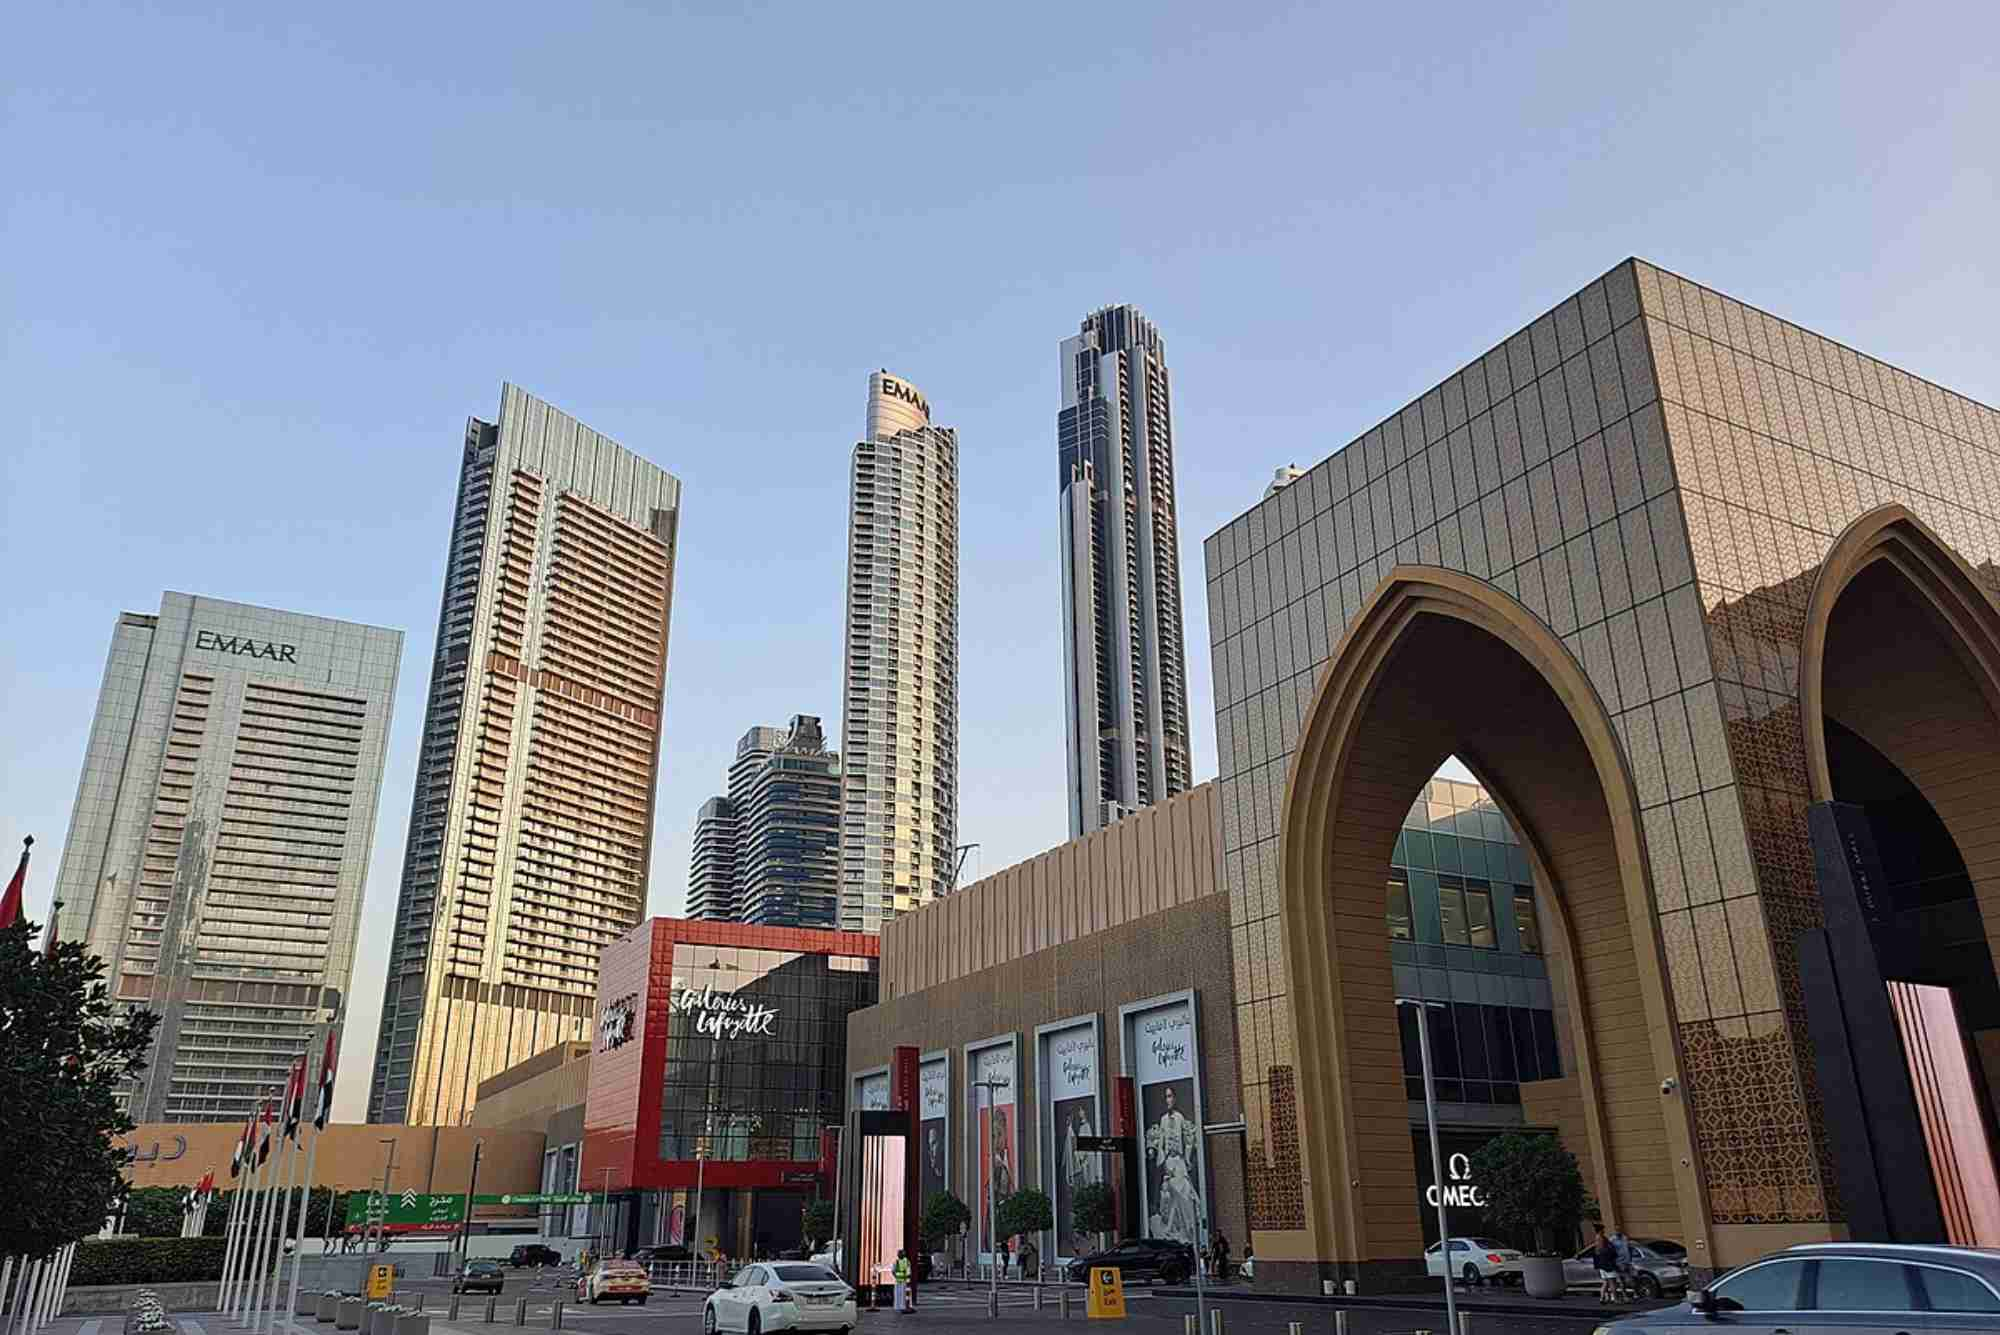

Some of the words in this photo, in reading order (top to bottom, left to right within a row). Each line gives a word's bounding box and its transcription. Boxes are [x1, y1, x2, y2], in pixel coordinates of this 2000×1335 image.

[196, 630, 297, 665] EMAAR
[680, 984, 747, 1016] Galeries
[696, 1004, 780, 1040] Lafayette
[1426, 1185, 1489, 1207] OMEG
